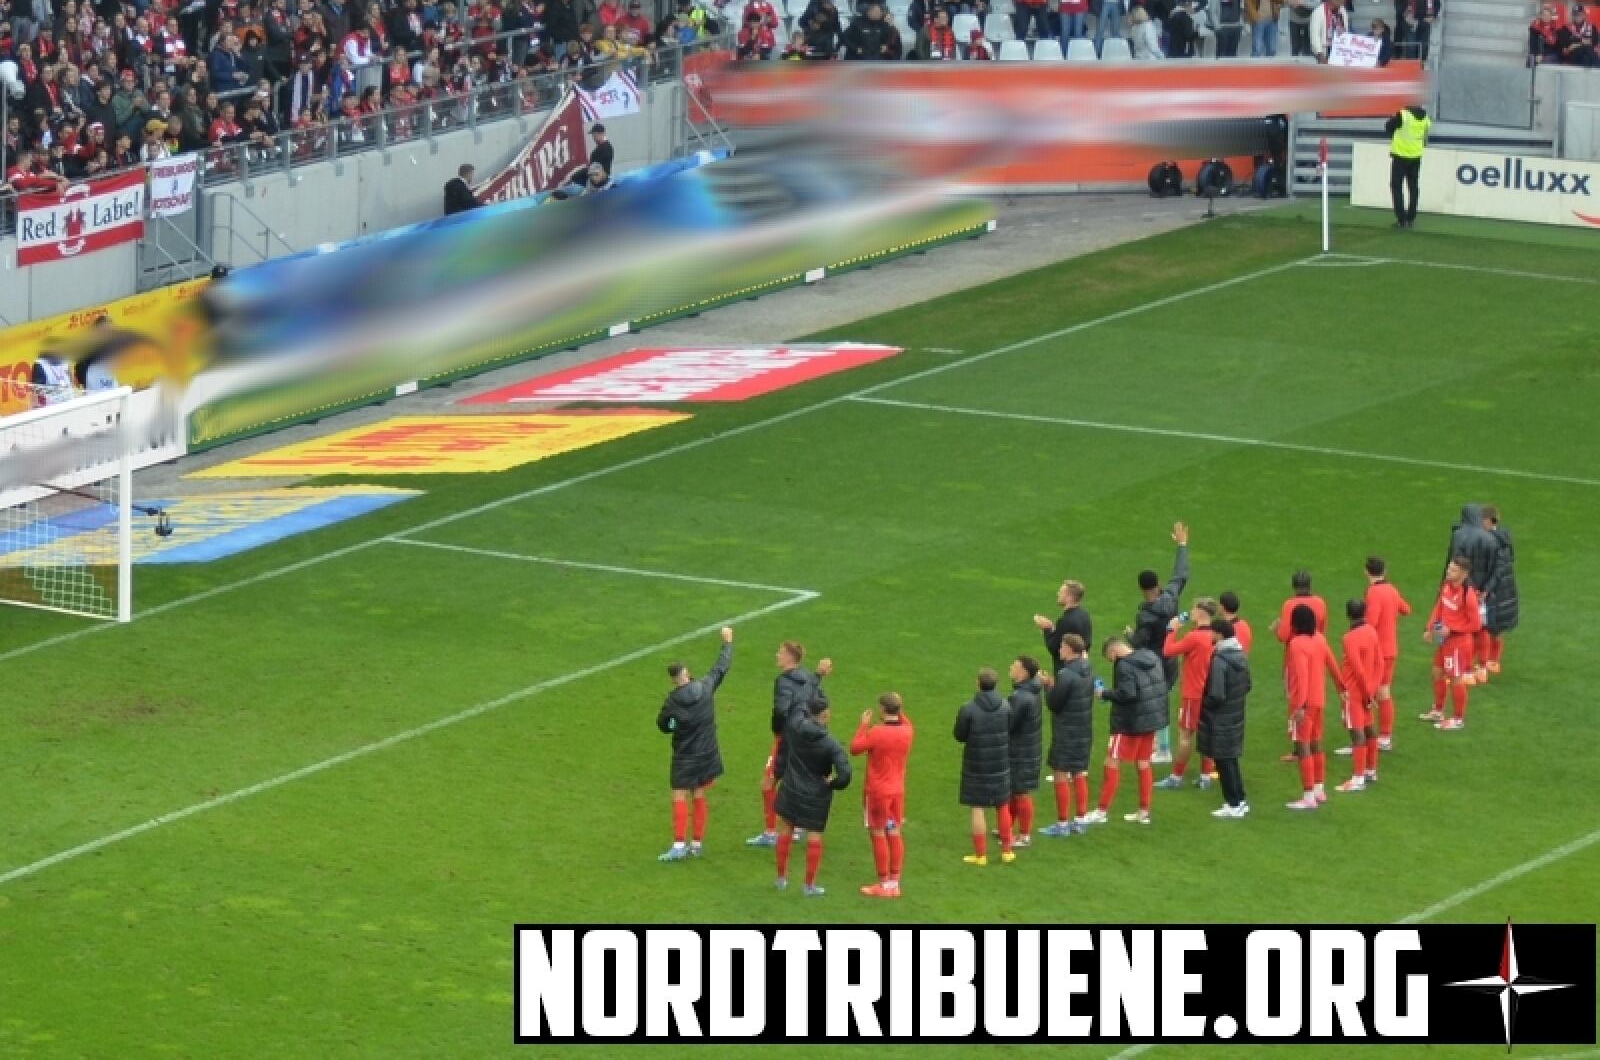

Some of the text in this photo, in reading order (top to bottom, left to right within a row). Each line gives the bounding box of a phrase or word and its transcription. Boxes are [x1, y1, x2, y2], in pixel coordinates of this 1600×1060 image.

[1456, 157, 1591, 197] oelluxx
[22, 217, 57, 242] Red
[92, 190, 140, 228] Label
